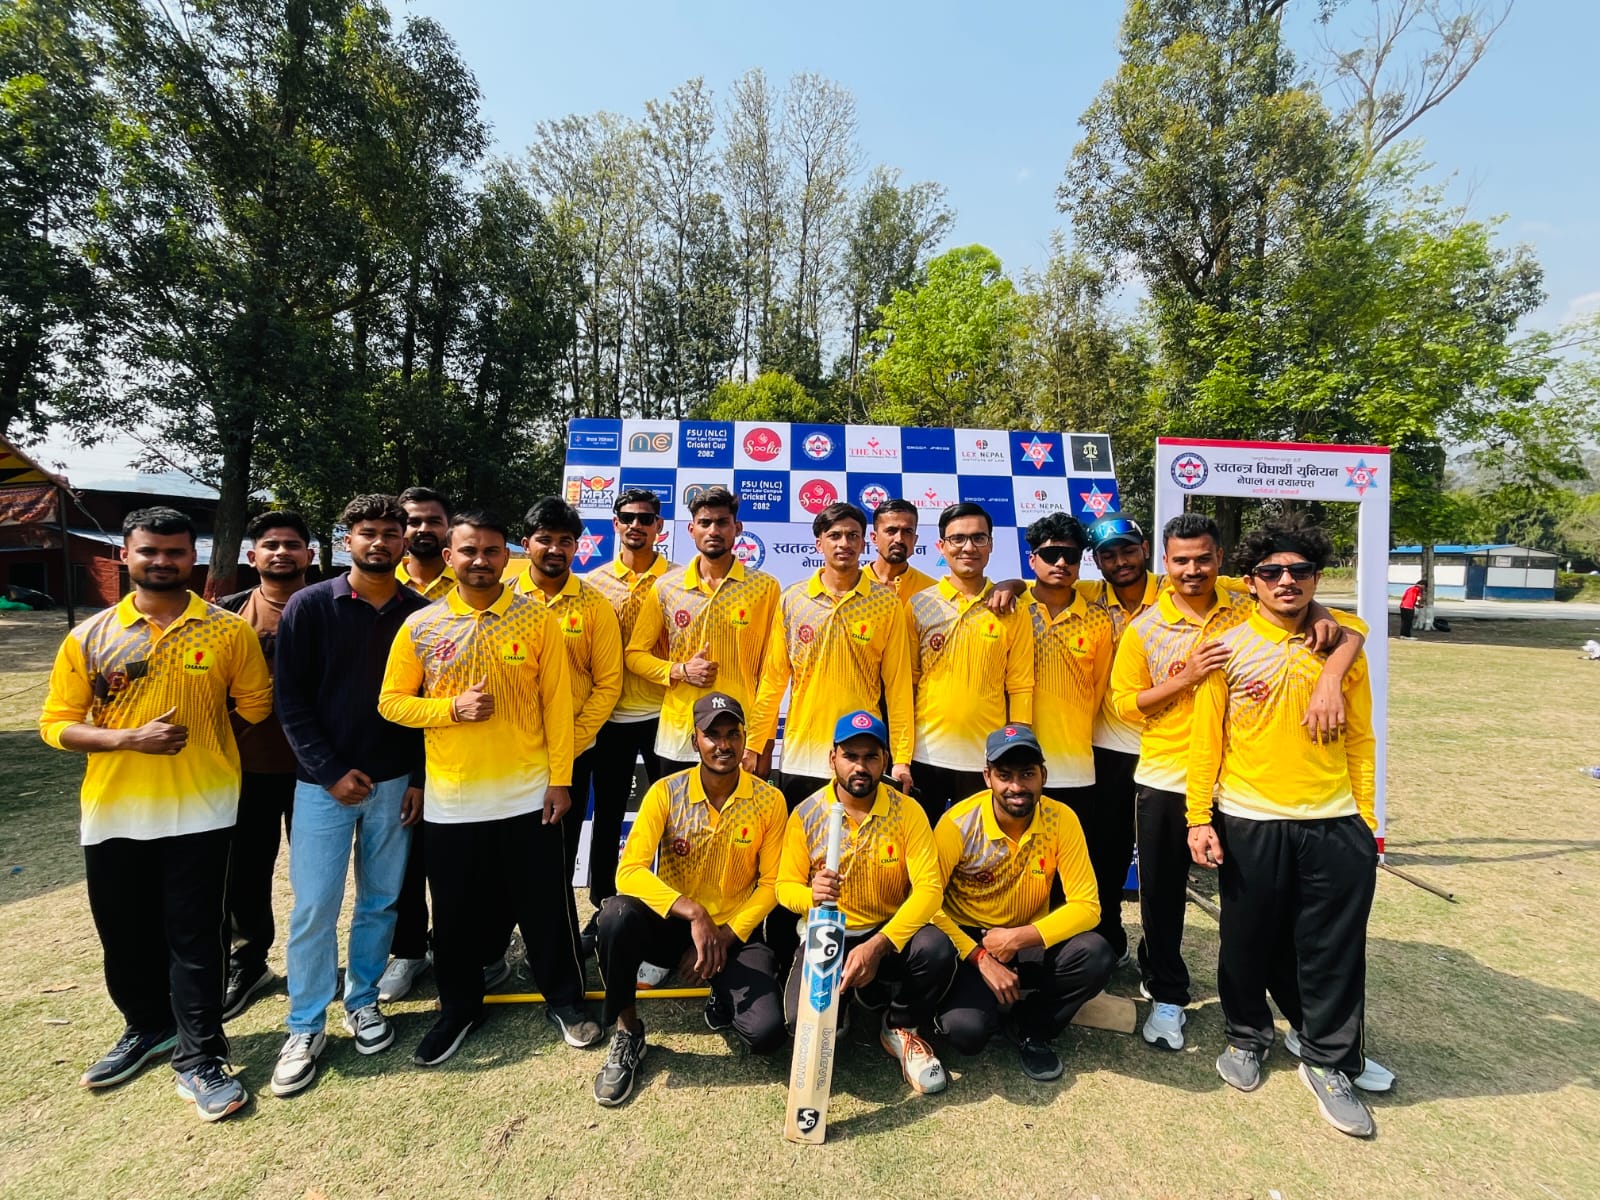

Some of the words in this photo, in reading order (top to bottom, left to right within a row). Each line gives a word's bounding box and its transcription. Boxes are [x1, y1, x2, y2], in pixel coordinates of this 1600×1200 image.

[686, 429, 703, 437] FSU
[704, 429, 727, 437] (NLC)
[687, 441, 711, 449] Cricket
[712, 442, 726, 450] Cup
[849, 448, 869, 456] THE
[871, 448, 897, 456] NEXT
[1296, 464, 1339, 478] युनियन
[760, 481, 783, 489] (NLC)
[1237, 475, 1263, 485] नेपाल
[1265, 478, 1275, 486] ल
[582, 490, 614, 500] MAX
[742, 493, 766, 501] Cricket
[768, 494, 782, 502] Cup
[752, 502, 770, 510] 2082
